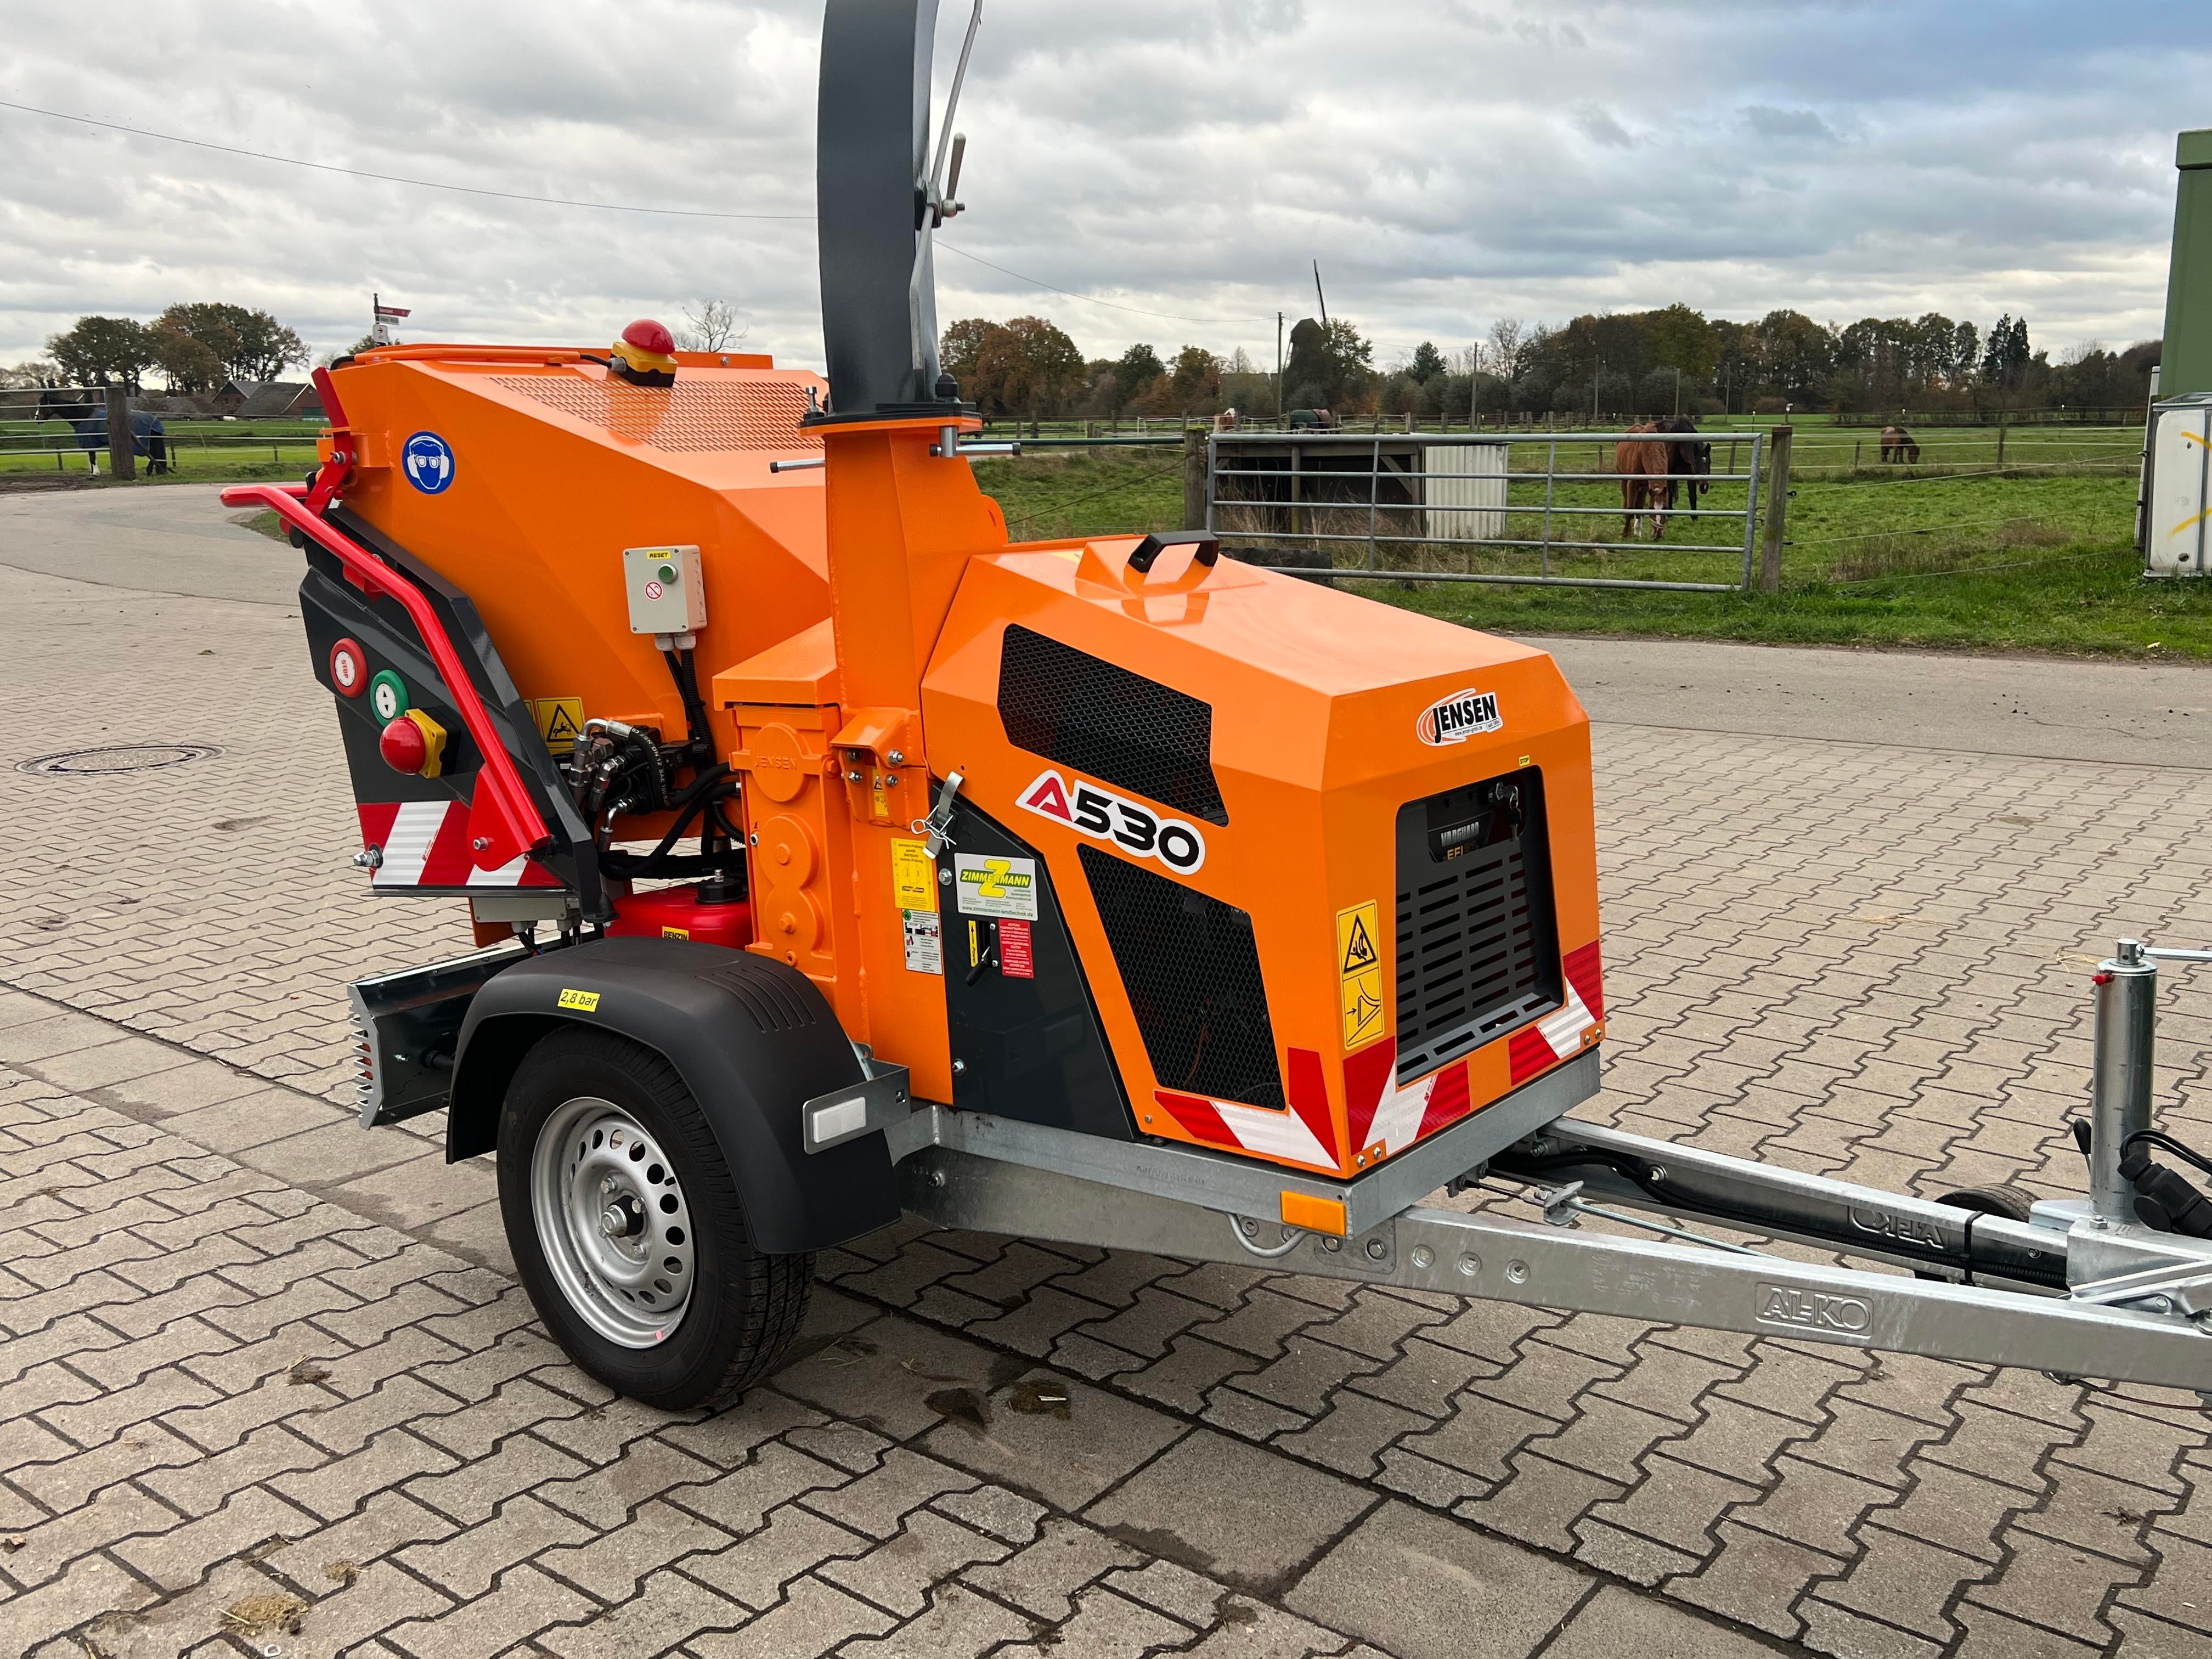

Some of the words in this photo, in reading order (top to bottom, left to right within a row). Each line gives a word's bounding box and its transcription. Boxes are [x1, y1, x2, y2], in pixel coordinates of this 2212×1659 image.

[1433, 695, 1497, 744] JENSEN
[755, 755, 797, 769] JENSEN
[1026, 777, 1199, 867] A530
[1441, 821, 1480, 848] VANGUARD
[1447, 845, 1463, 860] EFI
[961, 871, 1030, 887] ZIMMERMANN
[663, 930, 687, 941] BENZIN
[561, 991, 578, 1005] 2,8
[578, 994, 597, 1006] bar
[1762, 1286, 1871, 1331] AL-KO
